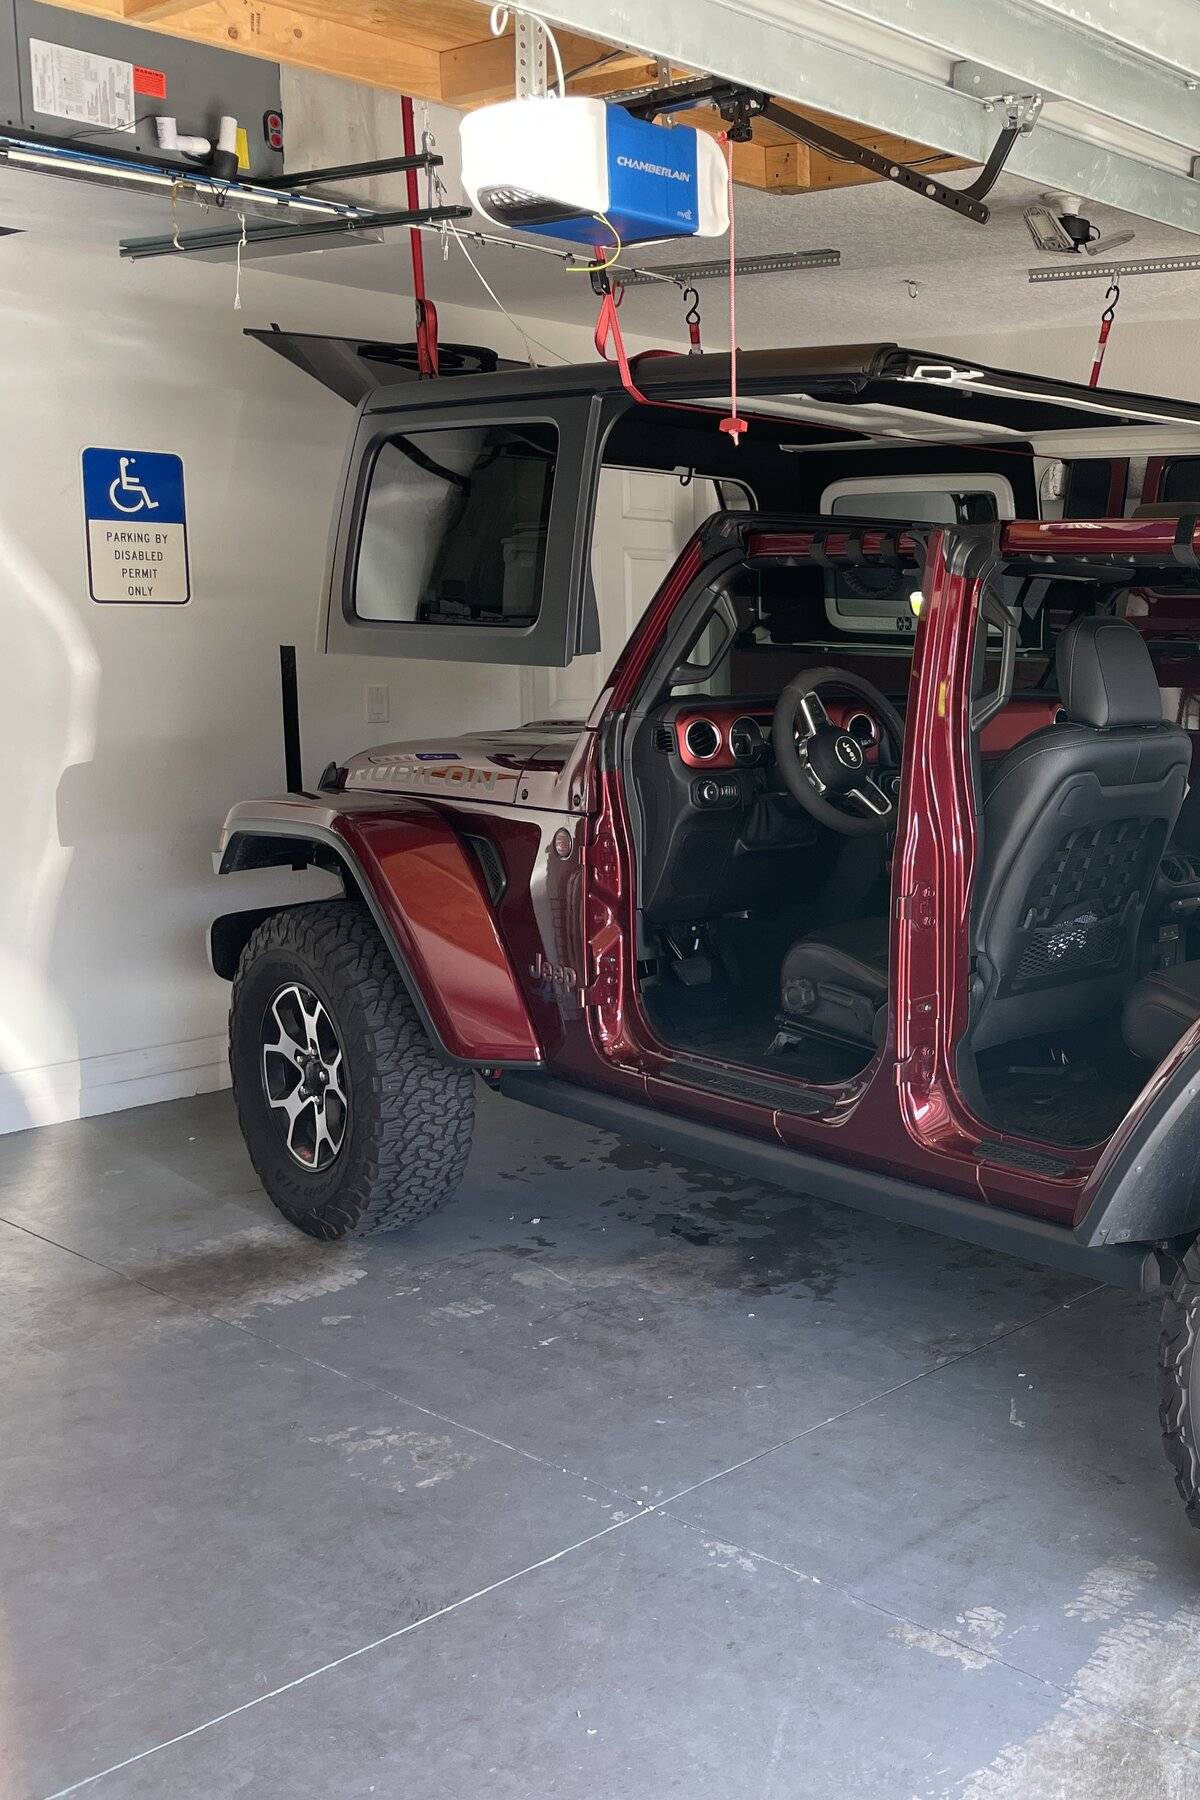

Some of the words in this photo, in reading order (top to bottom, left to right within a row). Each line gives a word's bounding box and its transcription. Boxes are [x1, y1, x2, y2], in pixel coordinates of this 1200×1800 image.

[616, 155, 690, 182] CHAMBERLAIN
[106, 531, 150, 543] PARKING
[155, 533, 168, 544] BY
[114, 549, 163, 562] DISABLED
[121, 567, 158, 579] PERMIT
[127, 585, 153, 597] ONLY
[841, 741, 857, 762] Jeep
[350, 766, 499, 791] RUBICON
[529, 952, 577, 993] Jeep
